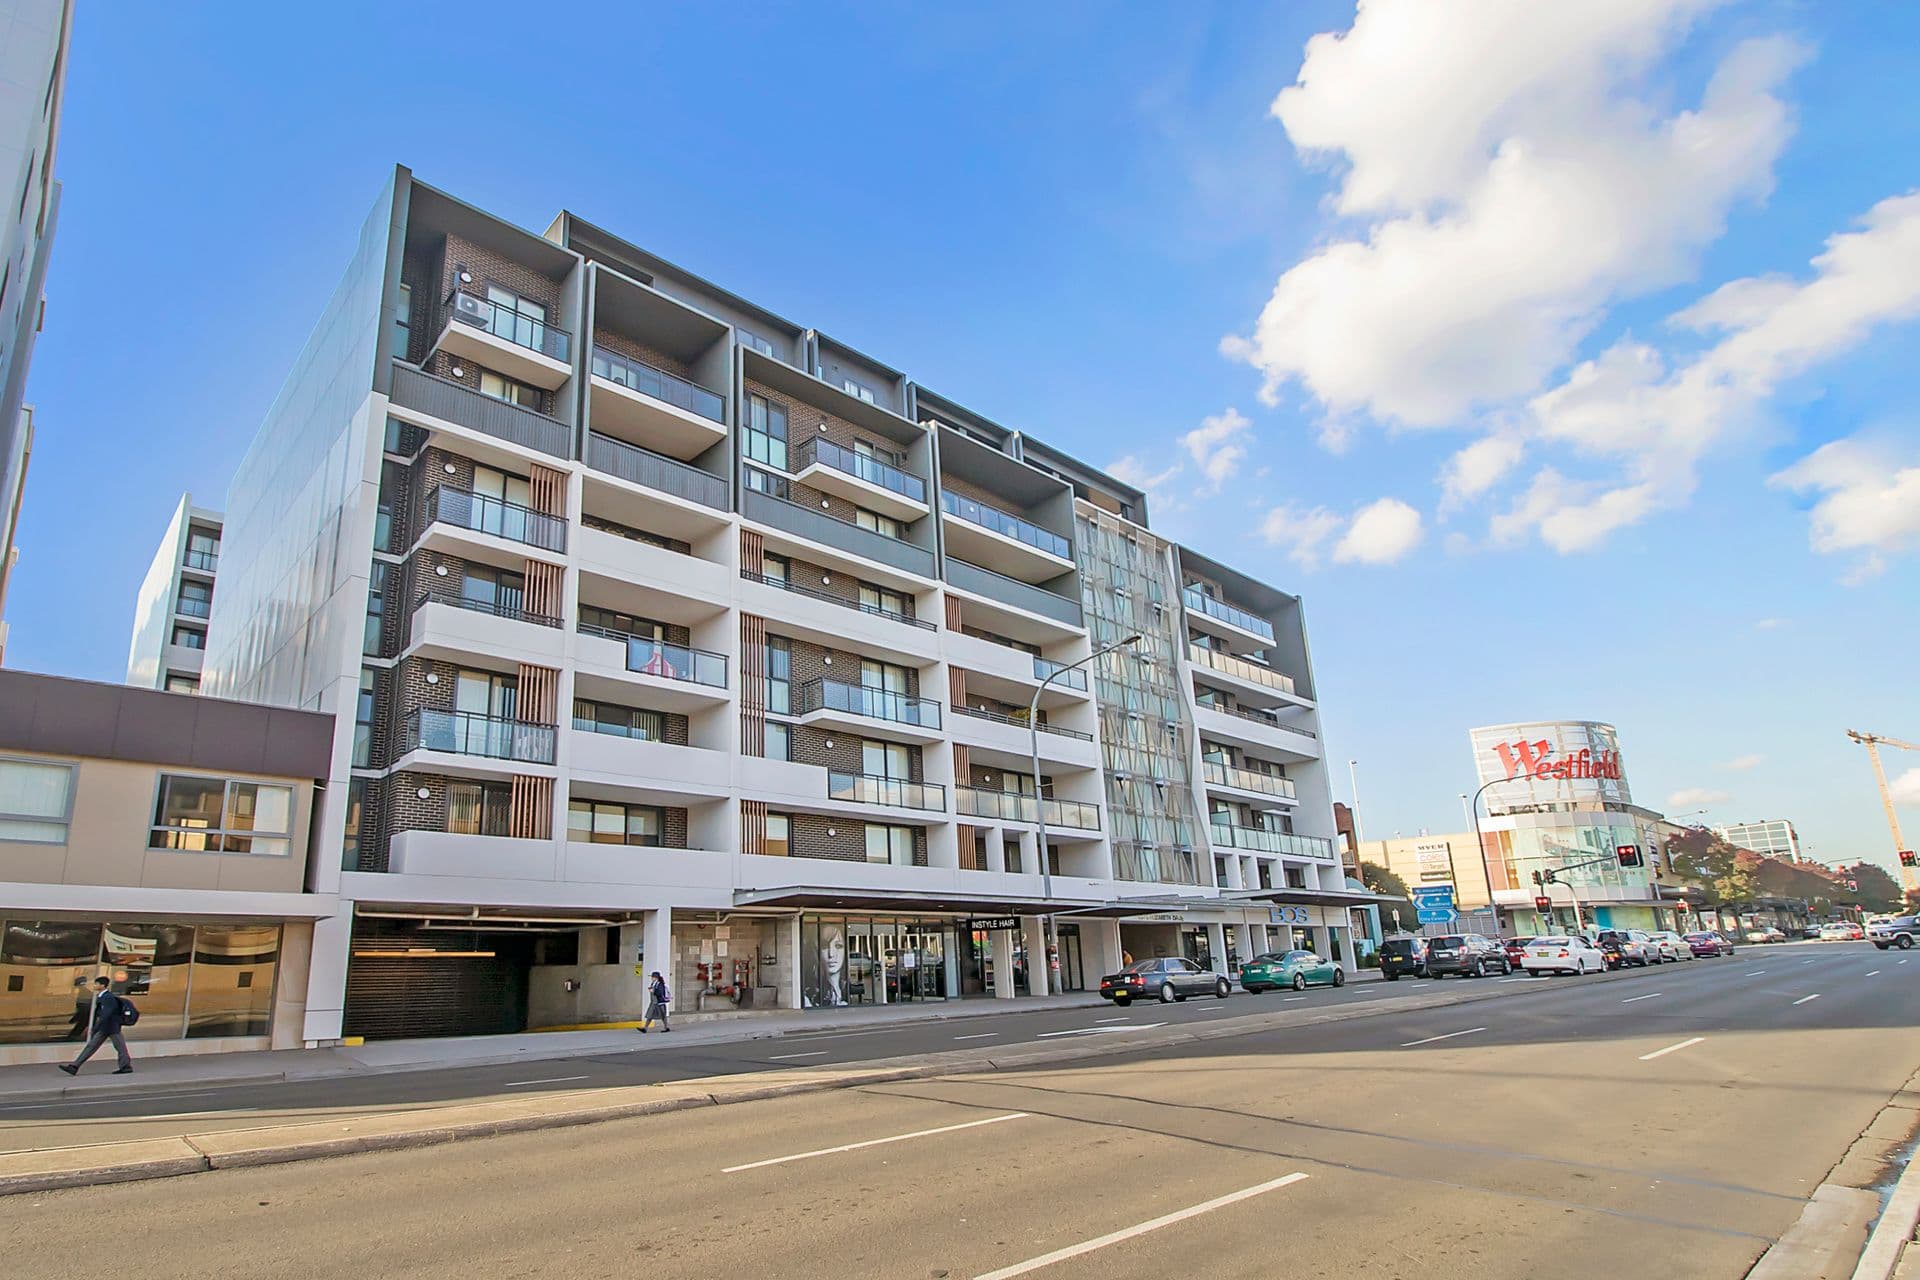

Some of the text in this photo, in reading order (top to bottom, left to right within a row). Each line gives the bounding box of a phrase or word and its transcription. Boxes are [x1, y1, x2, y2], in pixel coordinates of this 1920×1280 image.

[1492, 739, 1621, 783] Westfield
[972, 919, 1015, 928] INSTYLE HAIR
